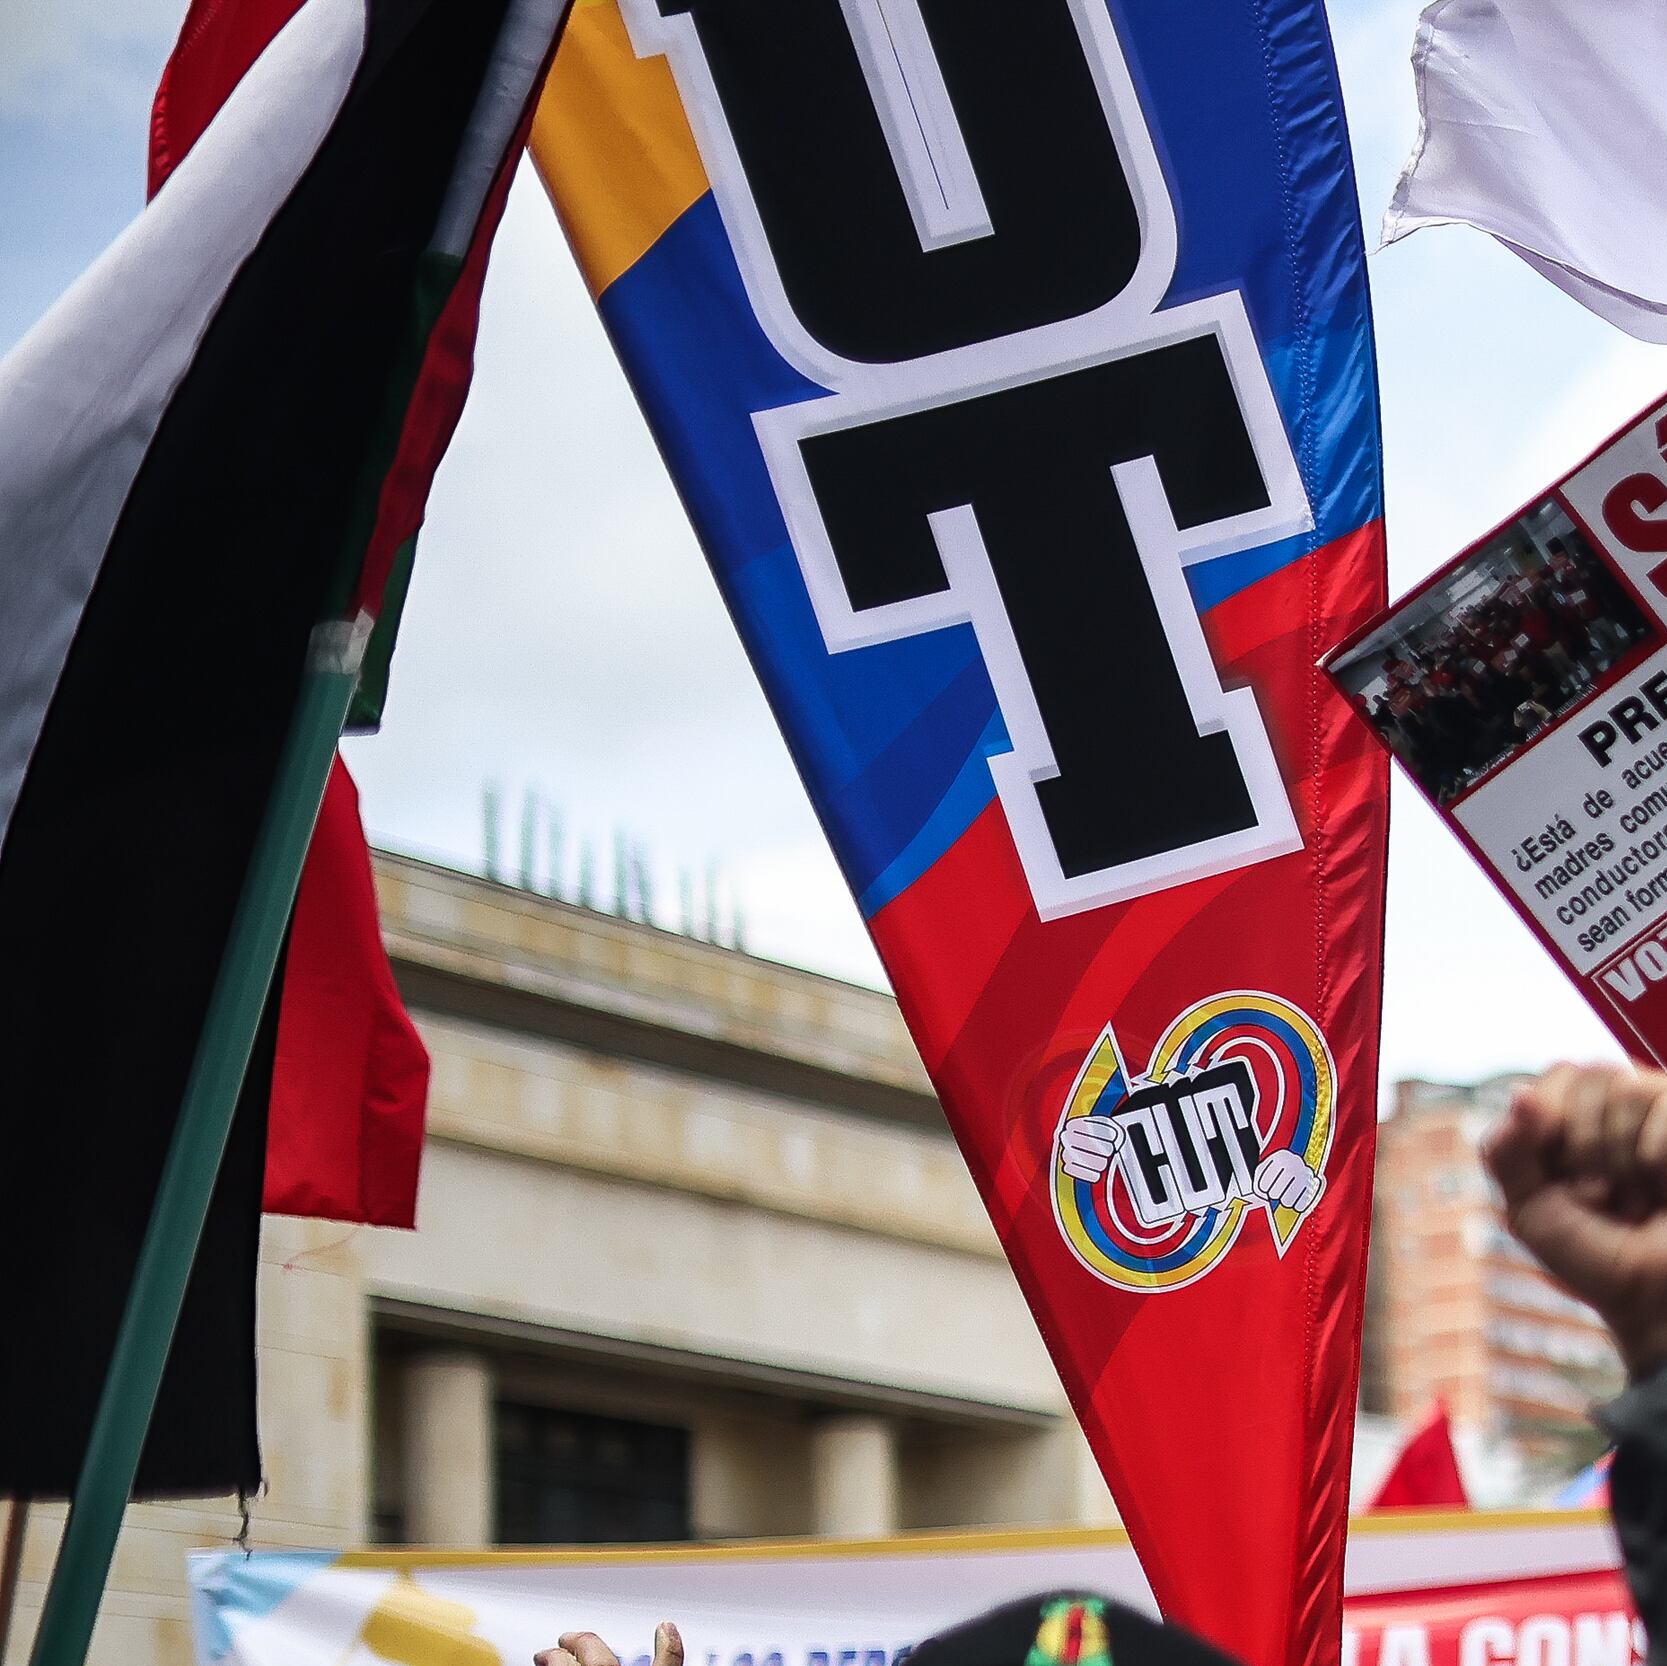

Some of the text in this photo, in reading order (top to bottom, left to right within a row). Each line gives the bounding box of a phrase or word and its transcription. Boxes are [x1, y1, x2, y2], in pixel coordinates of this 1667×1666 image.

[1511, 813, 1576, 871] ¿Está
[1583, 789, 1614, 818] de
[1534, 832, 1614, 899] madres
[1577, 905, 1631, 952] sean
[1112, 1083, 1256, 1224] CUT
